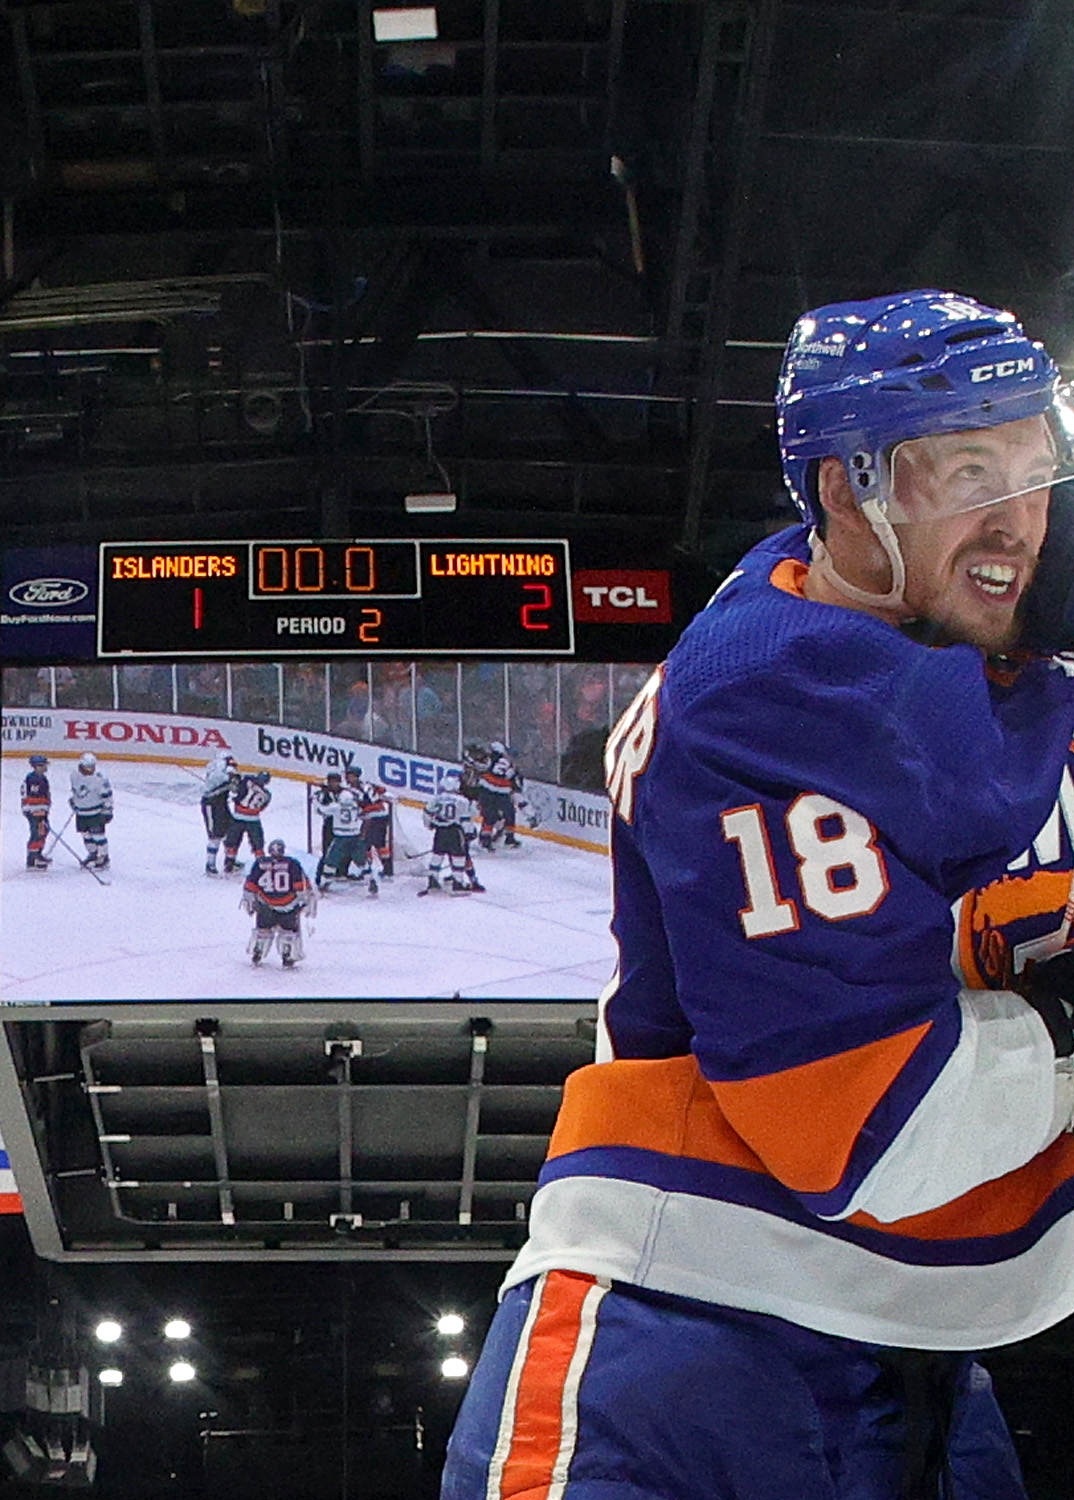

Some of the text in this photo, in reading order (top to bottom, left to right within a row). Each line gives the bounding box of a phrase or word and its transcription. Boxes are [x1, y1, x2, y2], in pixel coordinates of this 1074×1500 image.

[970, 357, 1034, 384] CCM
[112, 556, 236, 578] ISLANDERS
[431, 554, 554, 576] LIGHTNING
[23, 582, 74, 601] Ford
[520, 582, 552, 629] 2
[583, 586, 658, 608] TCL
[276, 608, 382, 642] PERIOD 2
[64, 720, 231, 749] HONDA
[257, 728, 354, 768] betway
[720, 790, 891, 940] 18
[258, 871, 291, 893] 40
